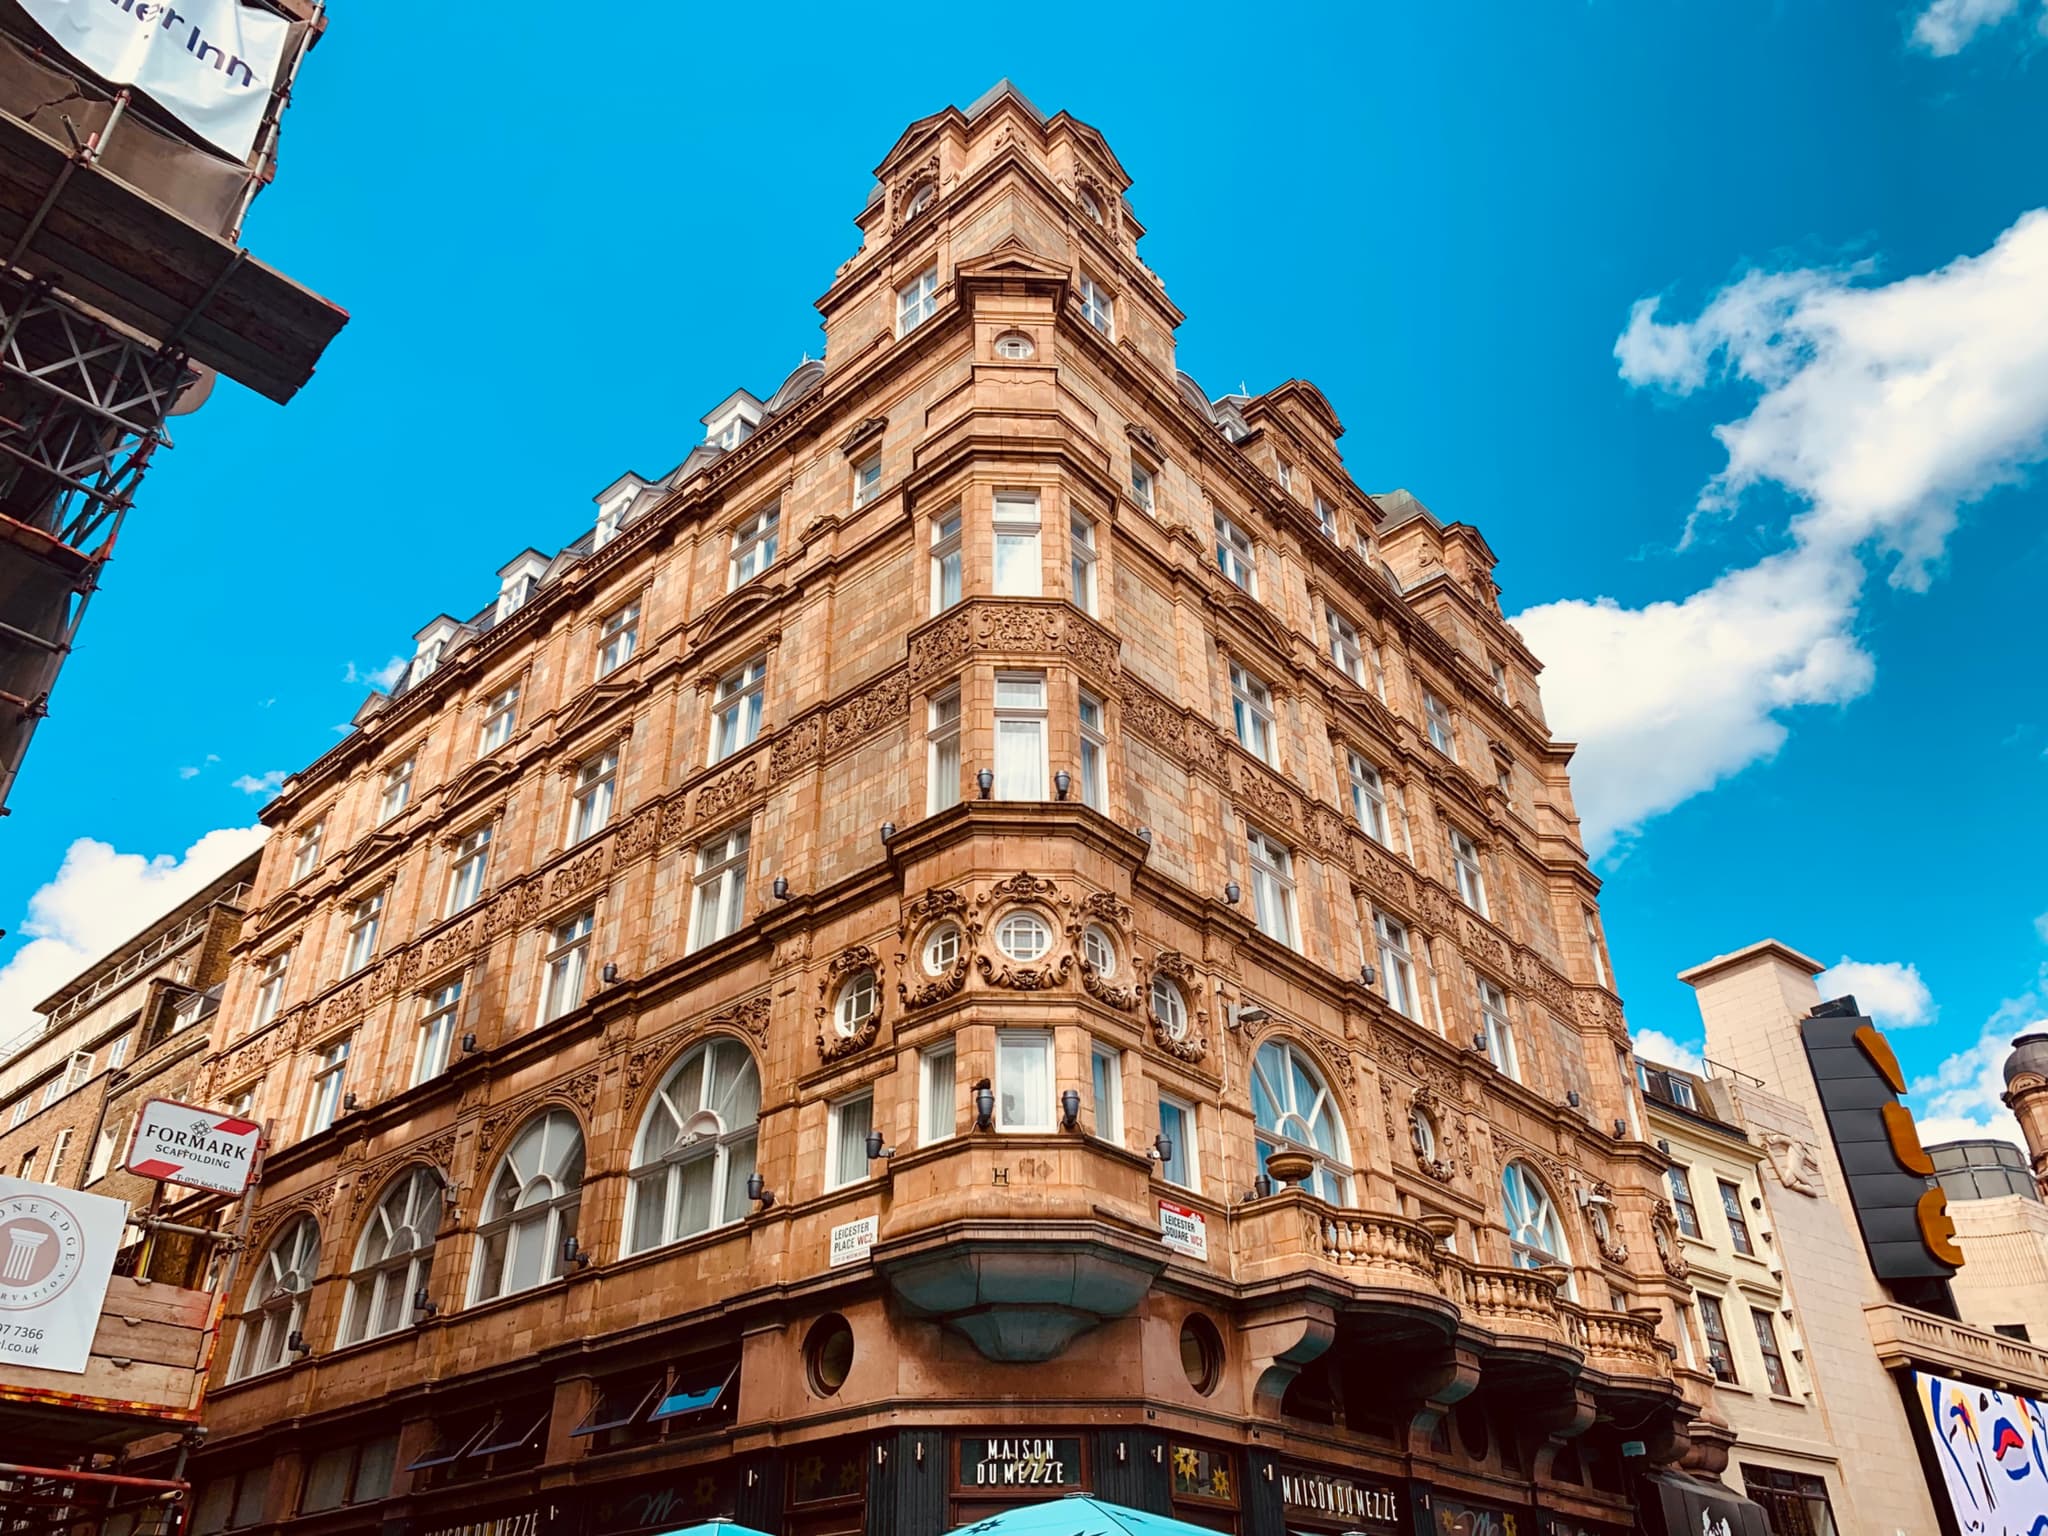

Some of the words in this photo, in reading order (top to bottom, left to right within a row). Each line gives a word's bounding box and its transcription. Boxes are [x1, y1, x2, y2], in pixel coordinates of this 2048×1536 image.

[186, 26, 254, 88] Inn
[145, 1123, 247, 1160] FORMARK
[155, 1144, 231, 1169] SCAFFOLDING
[834, 1221, 870, 1241] LEICESTER
[1164, 1213, 1195, 1233] LEICESTER
[834, 1237, 855, 1253] PLACE
[857, 1232, 873, 1246] WC2
[1166, 1225, 1189, 1243] SQUARE
[14, 1326, 44, 1340] 7366
[988, 1439, 1054, 1460] MAISON
[977, 1463, 997, 1485] DU
[1004, 1463, 1065, 1485] MEZZE
[1282, 1475, 1335, 1511] MAISON
[1336, 1485, 1353, 1515] DU
